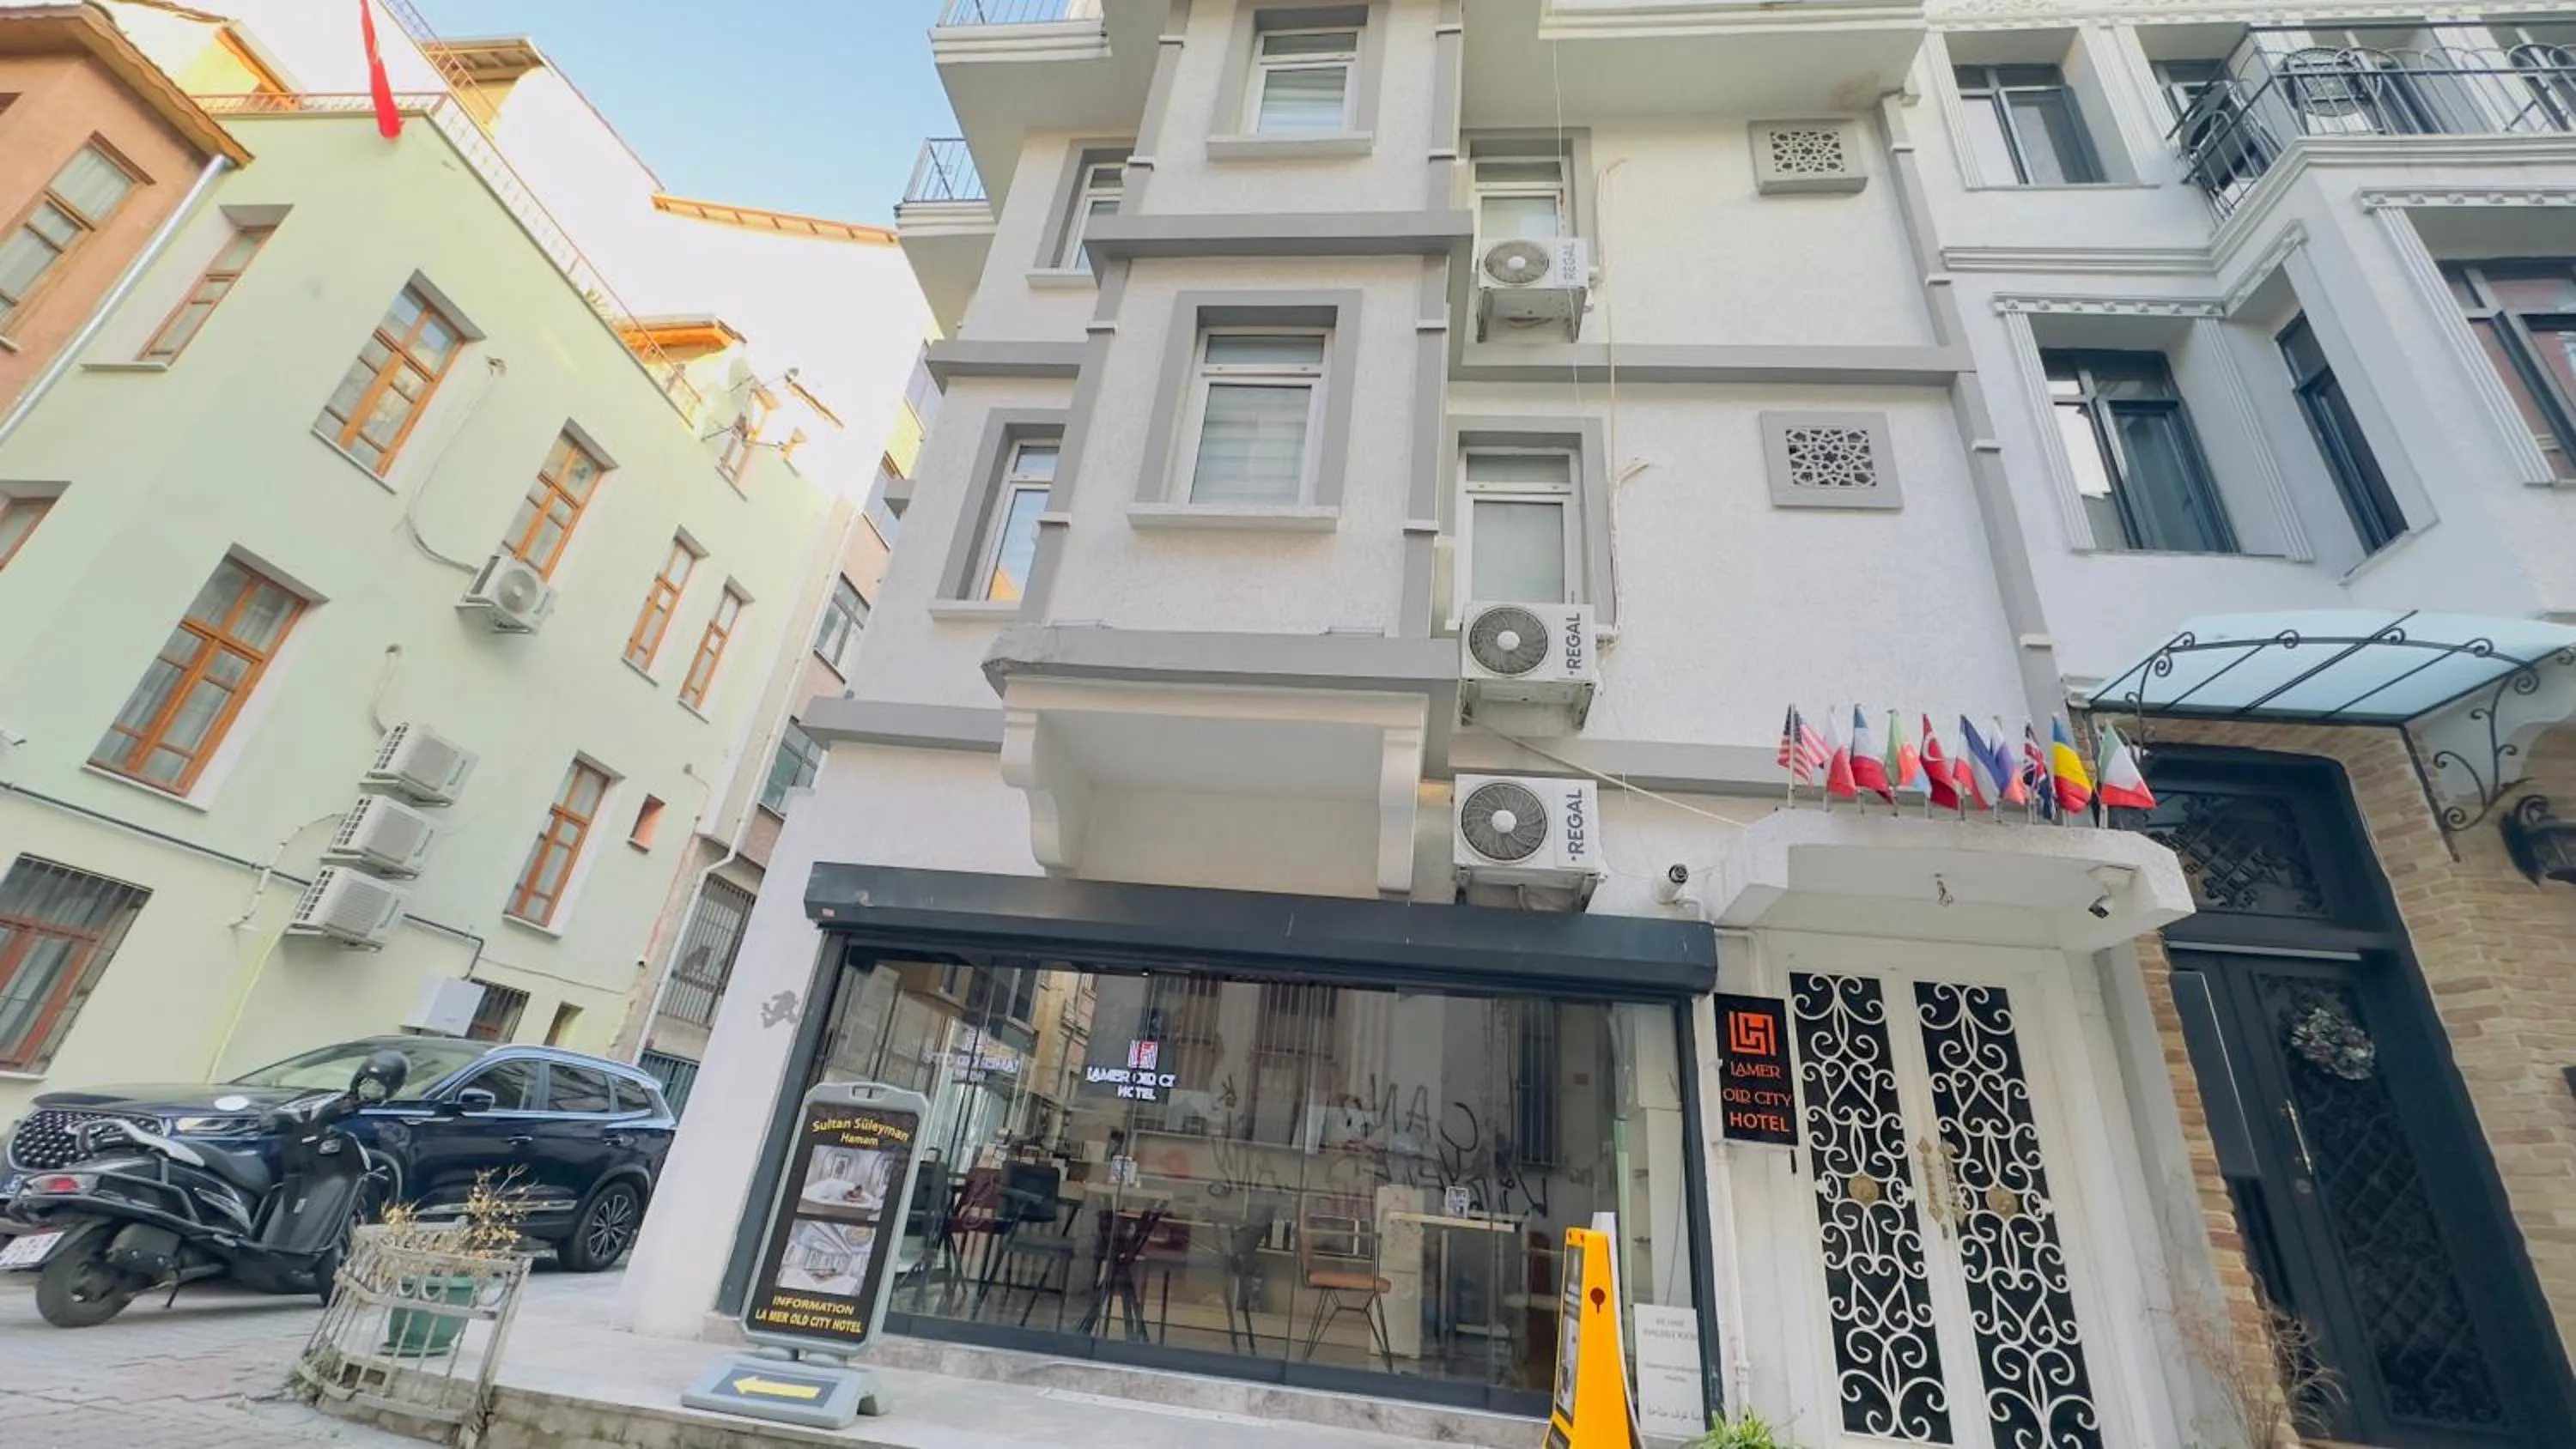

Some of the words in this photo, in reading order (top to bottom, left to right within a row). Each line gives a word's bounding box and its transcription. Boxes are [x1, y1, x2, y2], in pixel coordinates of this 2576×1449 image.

[1563, 242, 1576, 281] REGAL
[1565, 612, 1582, 670] REGAL
[1565, 788, 1584, 855] REGAL
[1729, 1060, 1782, 1080] LAMER
[1722, 1087, 1751, 1105] OLD
[1754, 1090, 1792, 1108] CITY
[811, 1117, 851, 1132] Sultan
[853, 1117, 909, 1142] Süleyman
[1729, 1111, 1790, 1133] HOTEL
[840, 1131, 879, 1146] Hamam
[772, 1294, 855, 1316] INFORMATION
[755, 1307, 768, 1320] LA
[789, 1313, 809, 1327] OLD
[810, 1315, 832, 1330] CITY
[832, 1319, 861, 1334] HOTEL
